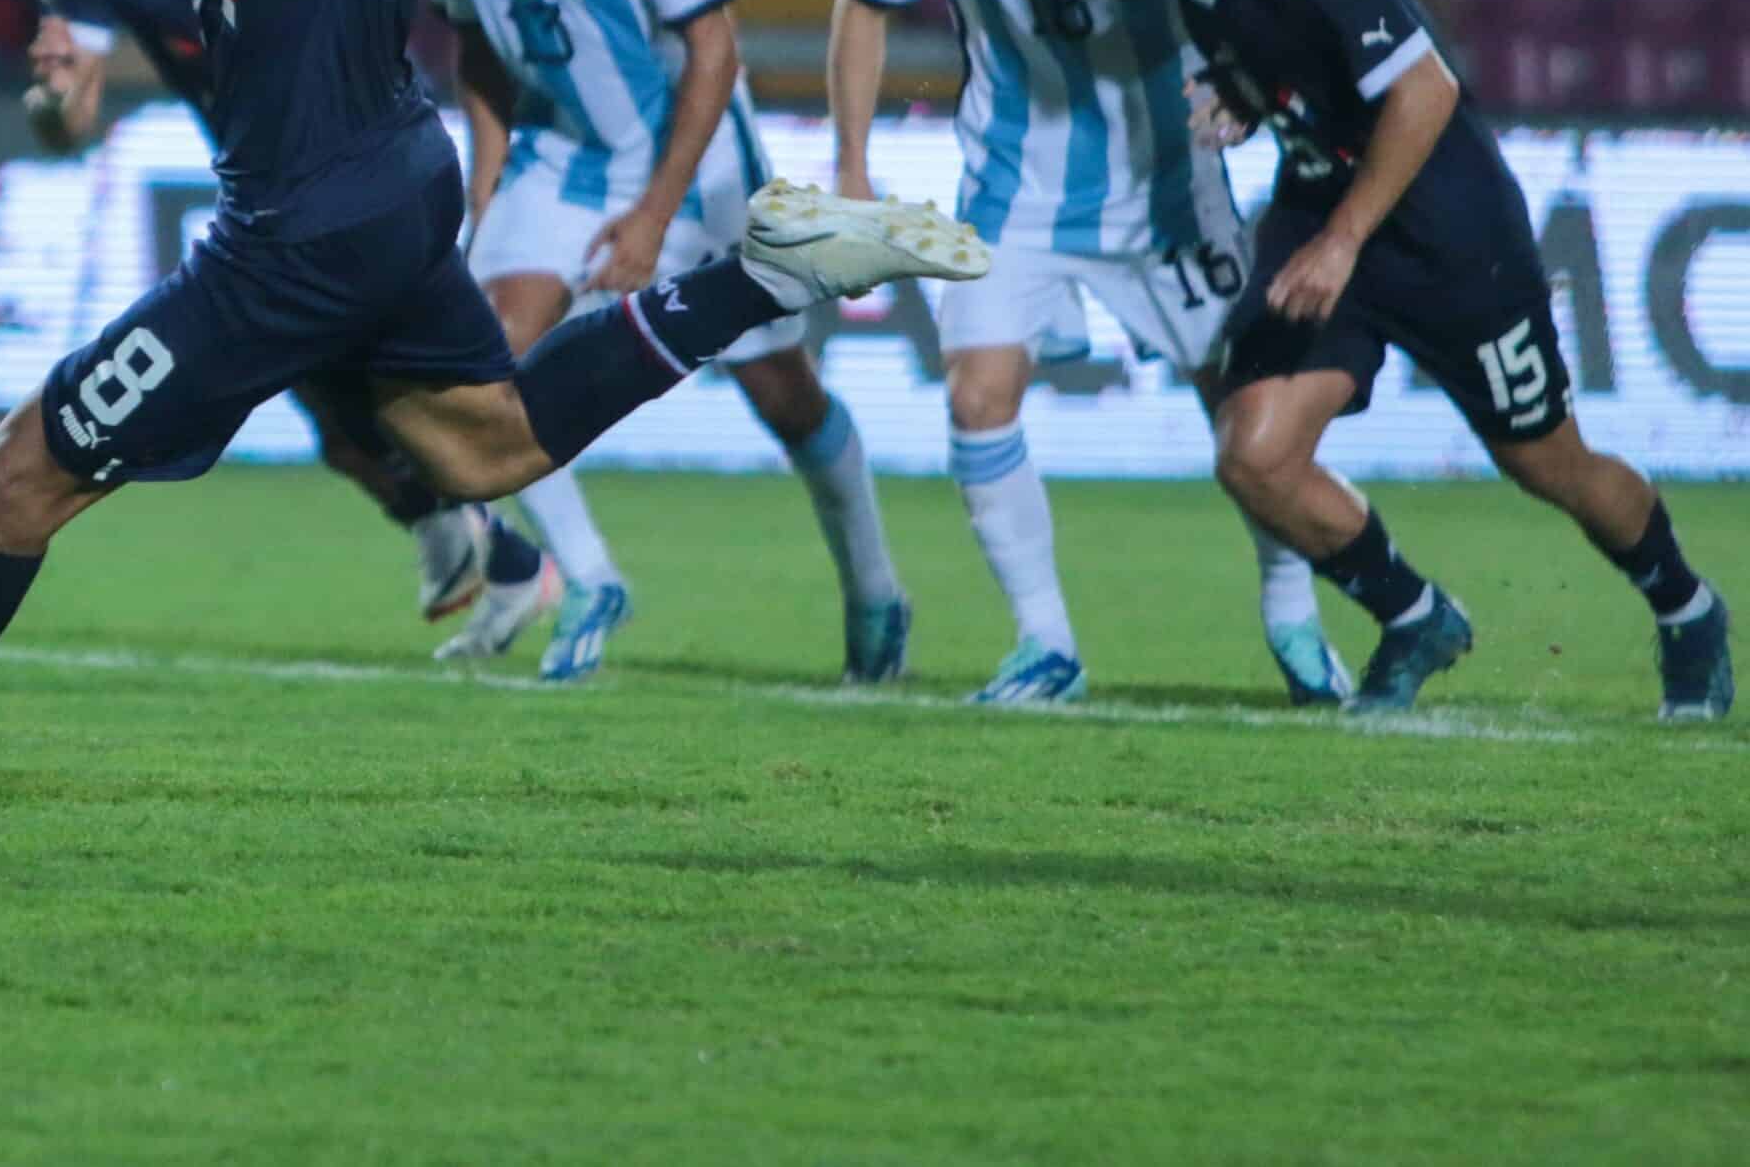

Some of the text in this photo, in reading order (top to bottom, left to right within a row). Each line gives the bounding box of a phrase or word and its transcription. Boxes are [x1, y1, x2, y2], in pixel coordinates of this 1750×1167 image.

[1161, 240, 1243, 309] 16
[79, 326, 176, 427] 8
[1476, 317, 1548, 411] 15
